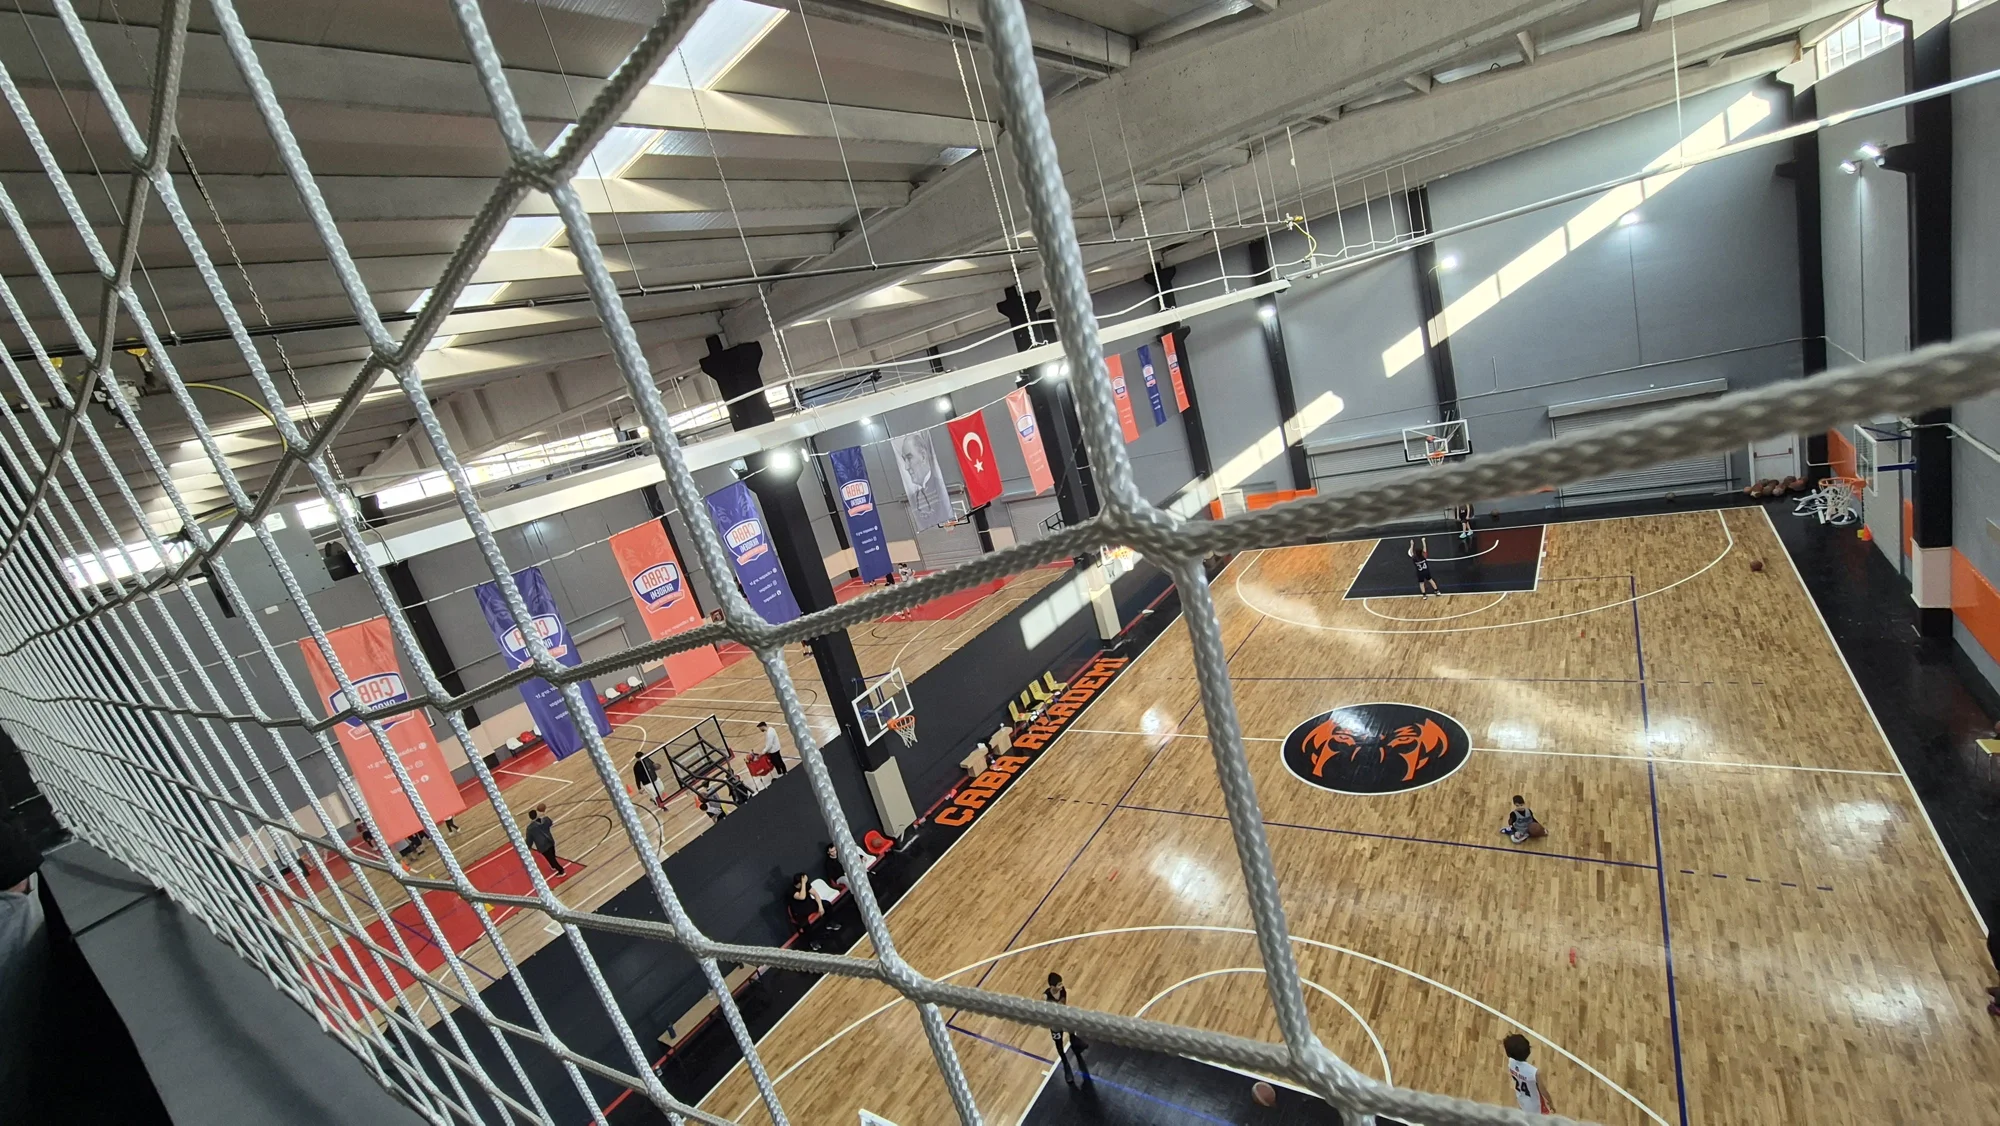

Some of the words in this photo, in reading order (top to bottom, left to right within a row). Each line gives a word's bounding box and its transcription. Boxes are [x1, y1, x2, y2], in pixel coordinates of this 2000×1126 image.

[1416, 563, 1427, 571] 34
[934, 755, 1031, 827] CABA
[1511, 1075, 1531, 1097] 24
